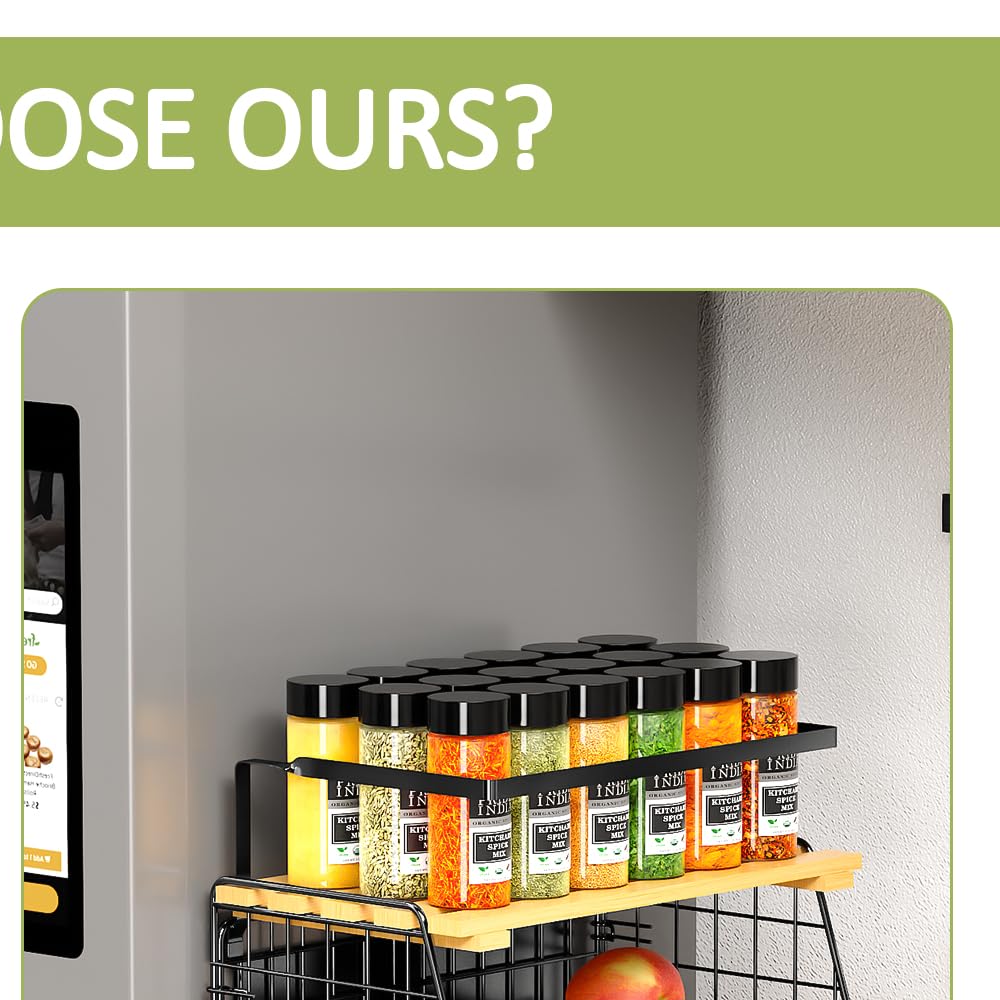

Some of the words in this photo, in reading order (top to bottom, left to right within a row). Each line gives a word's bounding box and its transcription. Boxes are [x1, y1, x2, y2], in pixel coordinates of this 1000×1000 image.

[775, 795, 797, 804] SPICE
[719, 804, 740, 813] SPICE
[780, 803, 794, 811] MIX
[662, 813, 684, 822] SPICE
[724, 813, 738, 821] MIX
[606, 823, 627, 832] SPICE
[668, 821, 682, 830] MIX
[546, 832, 568, 840] SPICE
[611, 831, 625, 839] MIX
[487, 842, 509, 850] SPICE
[552, 840, 566, 849] MIX
[492, 850, 506, 858] MIX
